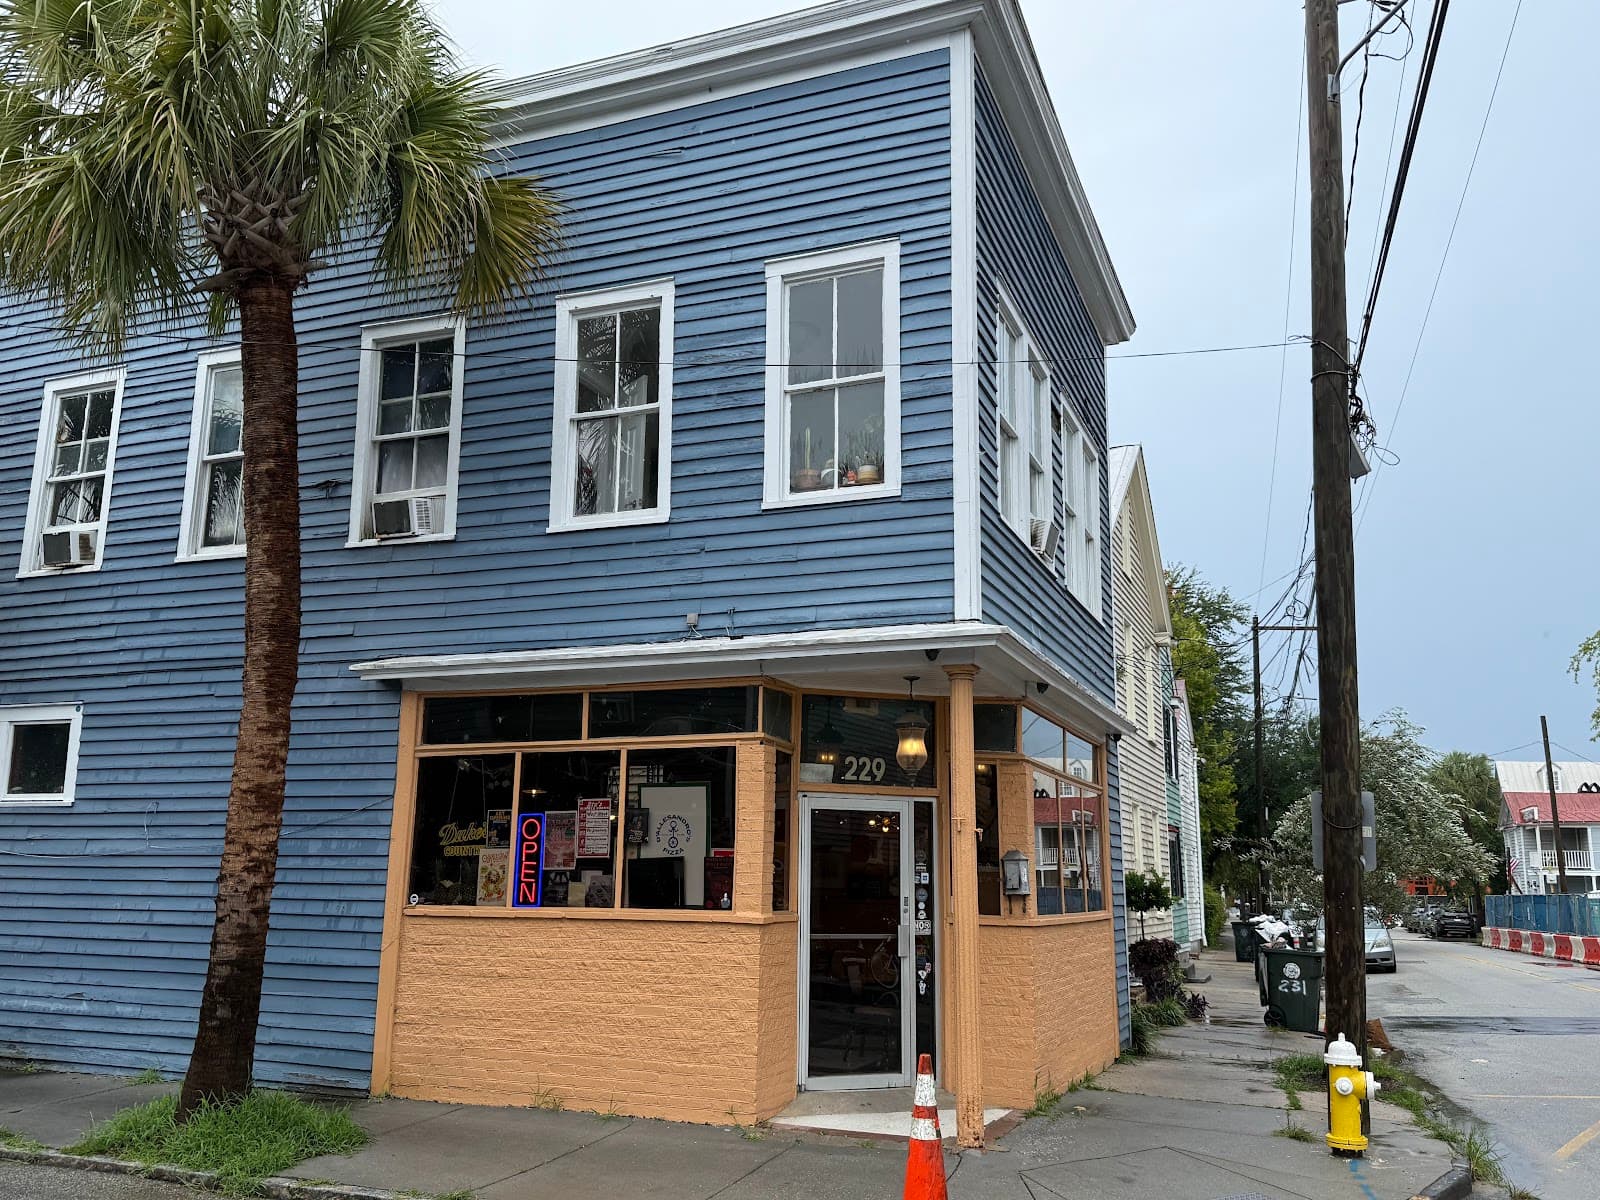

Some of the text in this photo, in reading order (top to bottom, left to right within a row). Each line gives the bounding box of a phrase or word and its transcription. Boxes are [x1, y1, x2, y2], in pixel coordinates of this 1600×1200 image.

[844, 756, 886, 782] 229
[519, 818, 540, 903] OPEN
[662, 847, 685, 856] PIZZA
[1278, 979, 1307, 996] 231
